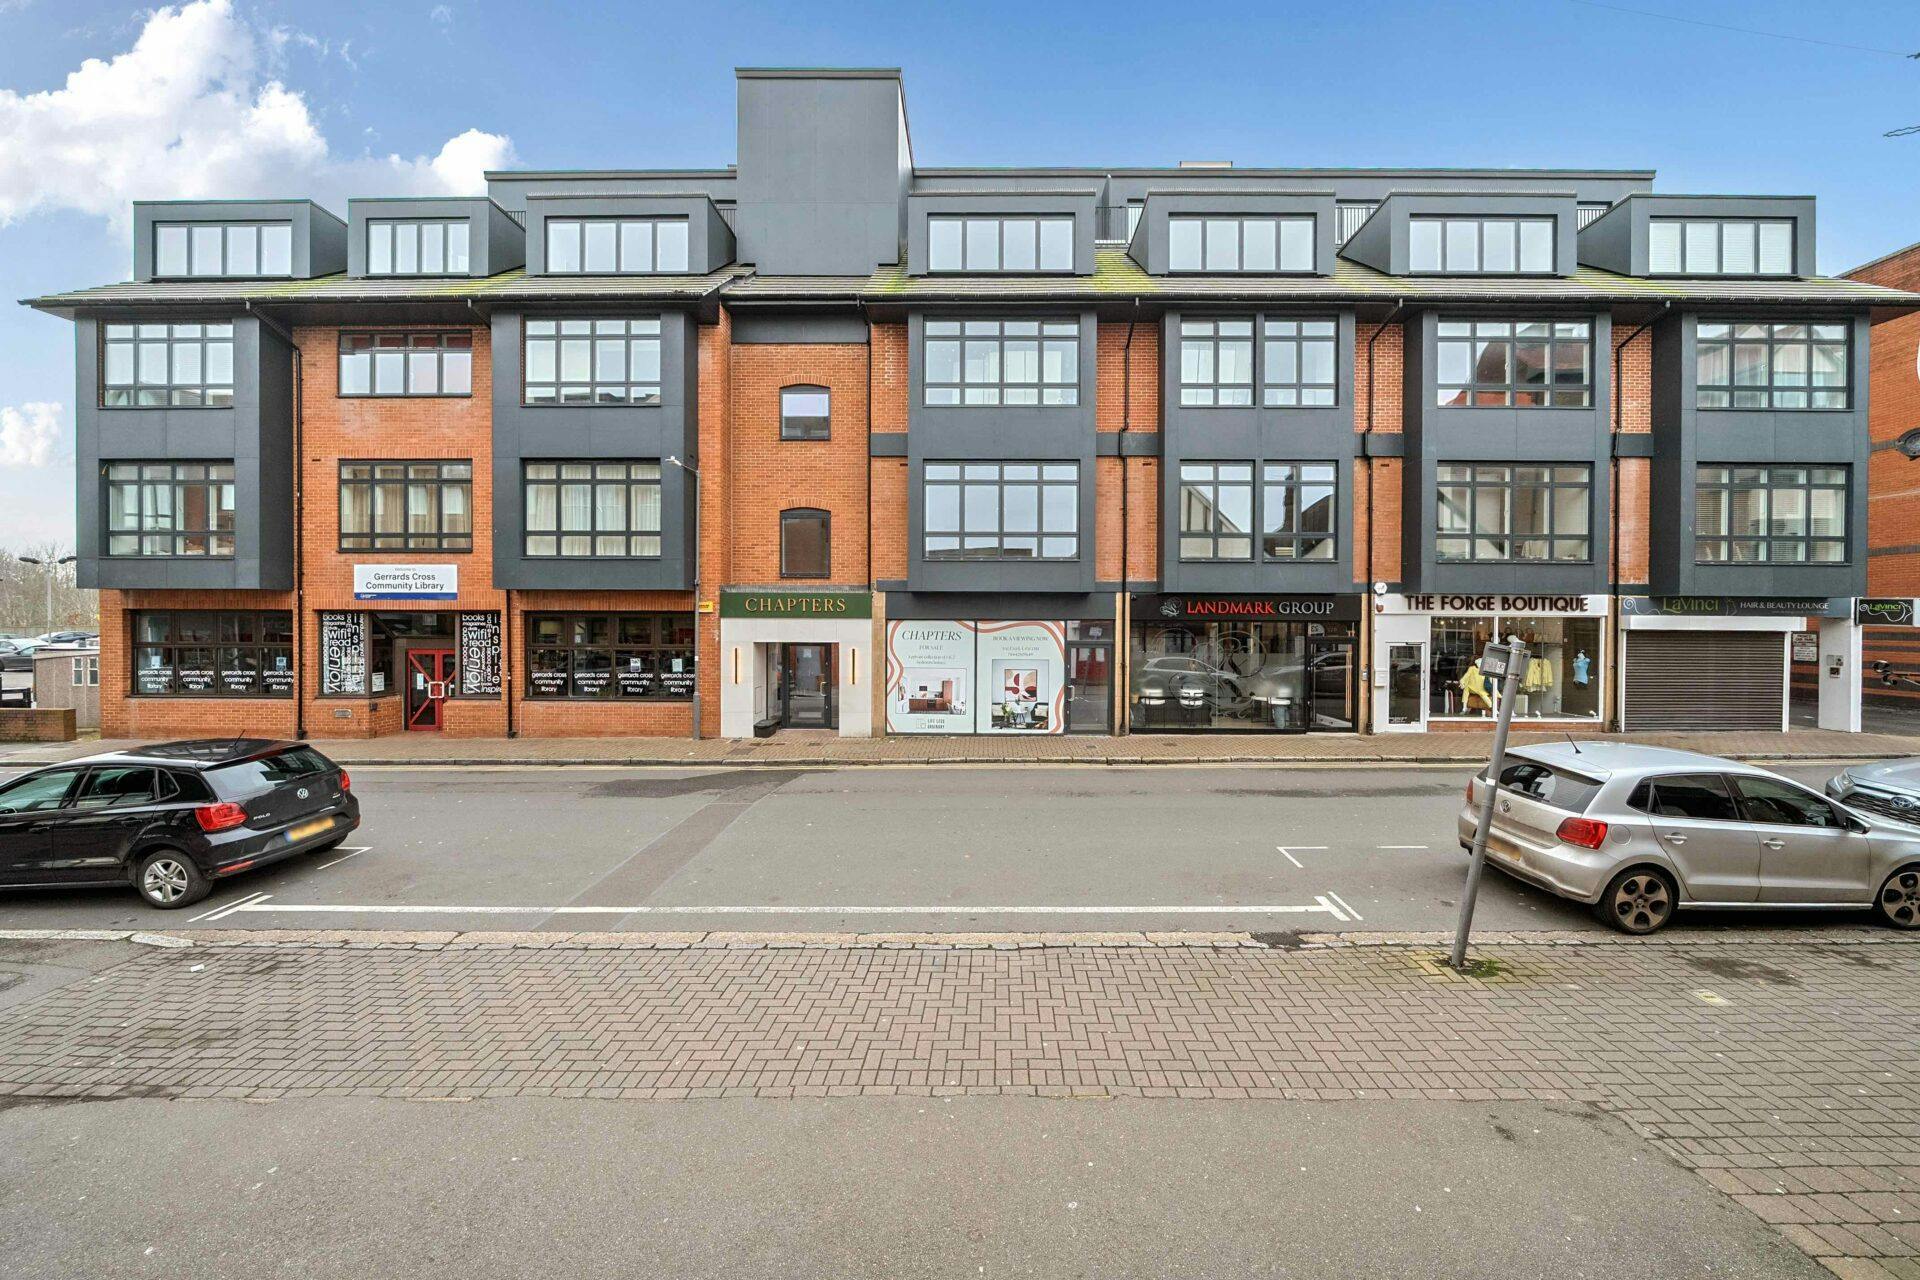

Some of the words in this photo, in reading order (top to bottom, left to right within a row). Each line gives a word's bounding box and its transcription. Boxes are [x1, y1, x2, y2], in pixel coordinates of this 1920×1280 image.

[373, 573, 410, 581] Gerrards
[411, 573, 436, 581] Cross
[365, 582, 413, 591] Community
[415, 582, 445, 591] Library
[745, 598, 846, 612] CHAPTERS
[1186, 601, 1276, 614] LANDMARK
[1278, 601, 1334, 615] GROUP
[1405, 594, 1434, 611] THE
[1440, 594, 1495, 611] FORGE
[1501, 595, 1589, 612] BOUTIQUE
[1662, 597, 1719, 614] LaVinci
[1797, 602, 1830, 610] LOUNGE
[1870, 603, 1901, 611] LaVinci
[328, 628, 347, 639] wifi
[467, 628, 487, 639] wifi
[902, 631, 962, 640] CHAPTERS
[469, 639, 491, 647] read
[492, 614, 500, 684] inspire
[327, 646, 340, 692] enjoy
[466, 647, 480, 693] enjoy
[253, 812, 270, 820] POLO
